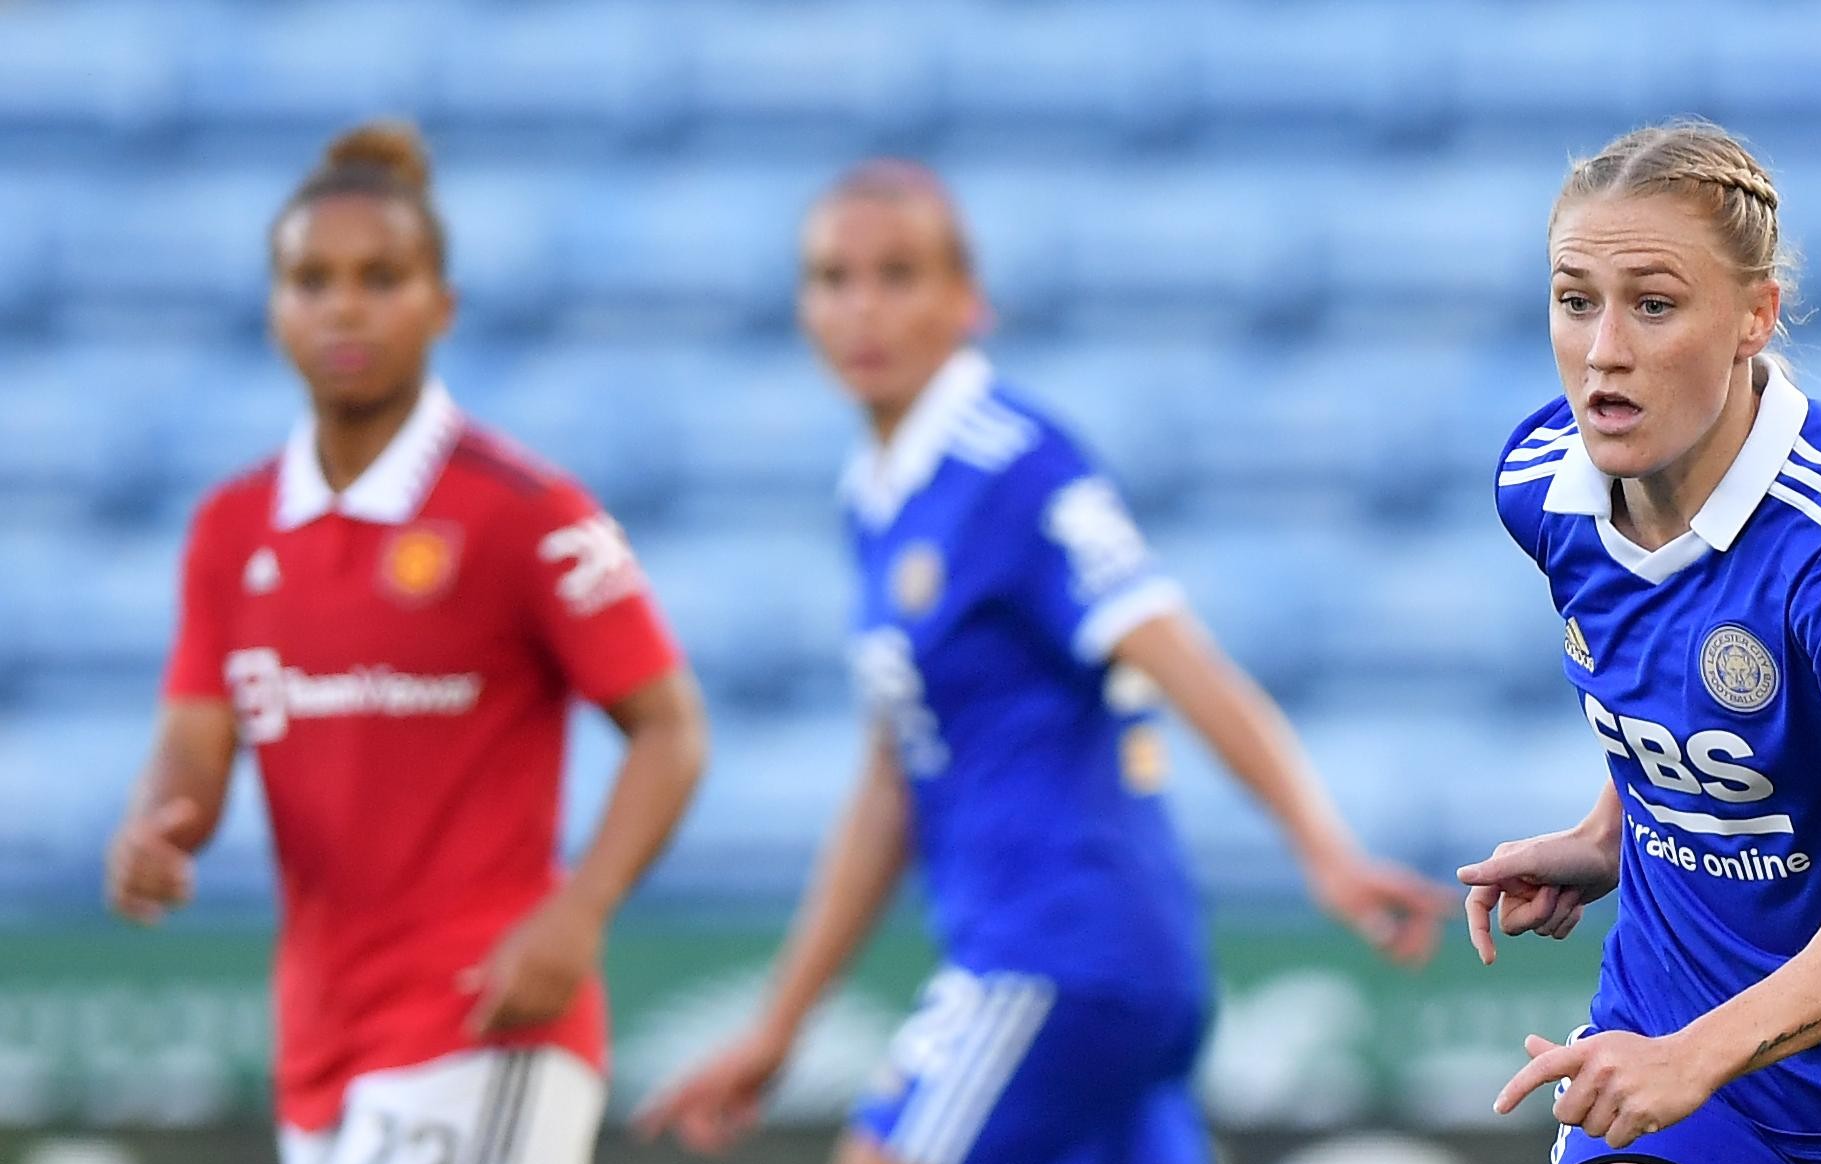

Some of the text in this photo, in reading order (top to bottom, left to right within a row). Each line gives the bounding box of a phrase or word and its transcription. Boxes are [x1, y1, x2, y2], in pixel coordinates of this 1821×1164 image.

[1707, 633, 1769, 668] LEICESTER CITY
[1707, 670, 1772, 703] FOOTBALL CLUB
[1584, 692, 1774, 804] FBS
[1627, 814, 1811, 881] rade online
